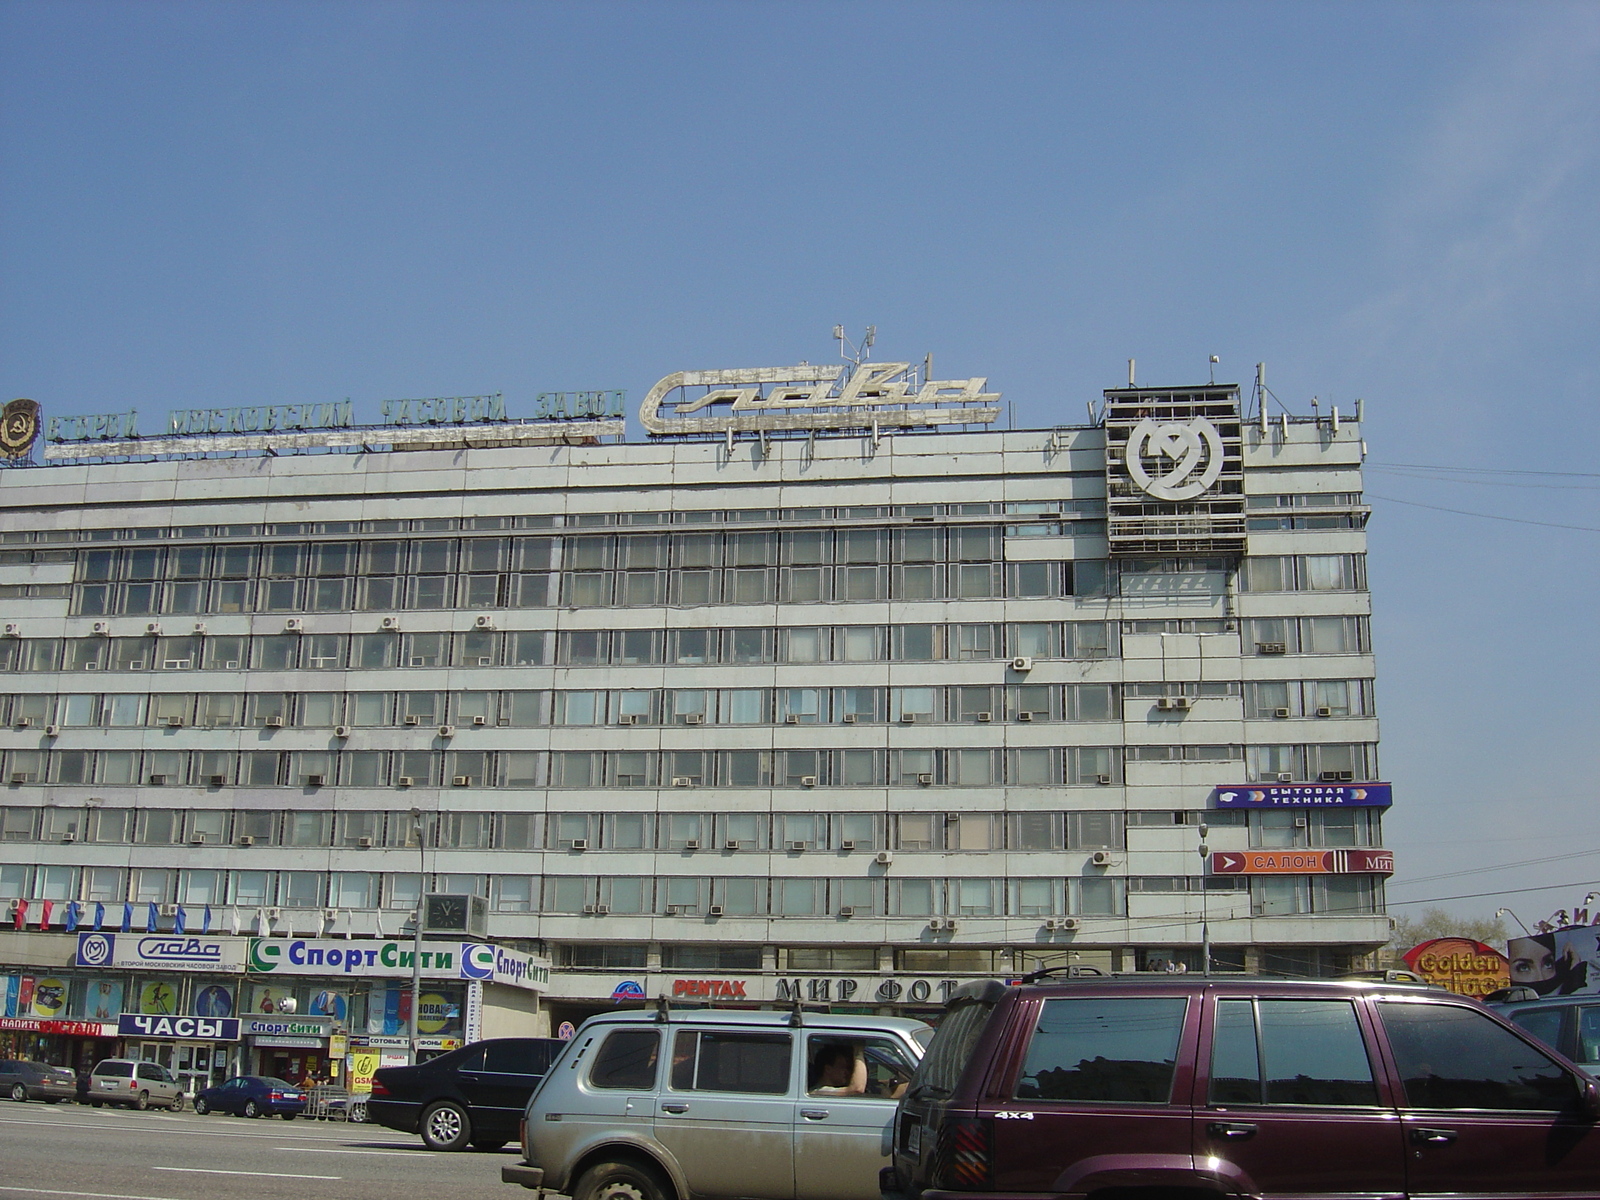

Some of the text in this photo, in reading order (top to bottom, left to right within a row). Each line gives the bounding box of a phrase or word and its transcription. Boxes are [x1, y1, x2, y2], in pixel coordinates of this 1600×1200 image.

[46, 389, 627, 440] ВТОРОЙ МОСКОВСКИЙ ЧАСОВОЙ ЗАВОД
[1270, 787, 1344, 795] БЫТОВАЯ
[1253, 856, 1317, 869] САЛОН
[289, 940, 453, 973] СпортСити
[1421, 953, 1500, 971] Golden
[497, 949, 549, 985] СпортСити
[674, 980, 746, 996] PENTAX
[778, 978, 957, 1000] МИР ФОТ
[419, 1004, 443, 1014] НОВА
[1, 1019, 40, 1029] НАПИТК
[134, 1016, 223, 1037] ЧАСЫ
[251, 1022, 322, 1035] СпортСити
[370, 1038, 402, 1046] СОТОВЫЕ
[994, 1111, 1035, 1120] 4x4
